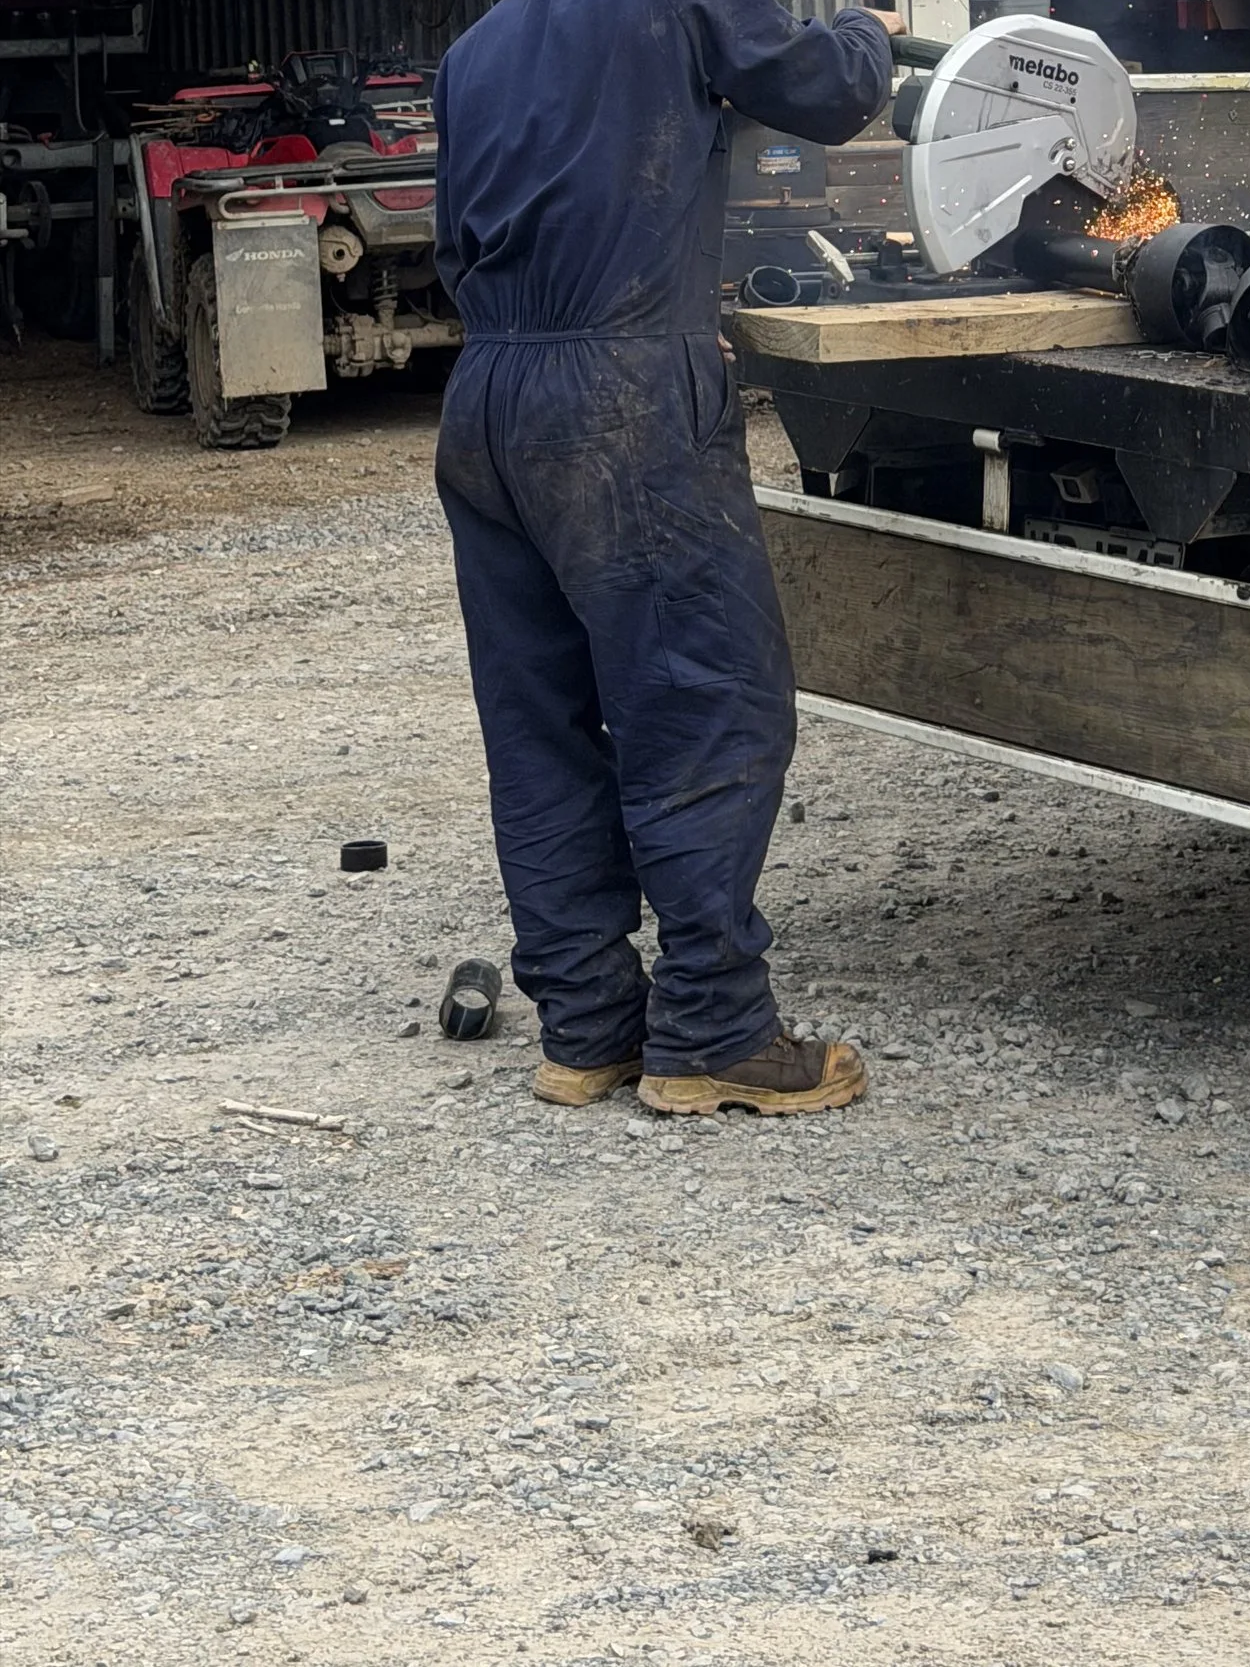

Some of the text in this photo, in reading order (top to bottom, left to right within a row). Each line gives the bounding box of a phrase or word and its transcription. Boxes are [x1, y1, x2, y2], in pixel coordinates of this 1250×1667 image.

[1009, 54, 1079, 86] metabo
[1043, 80, 1054, 90] CS
[243, 248, 305, 262] HONDA
